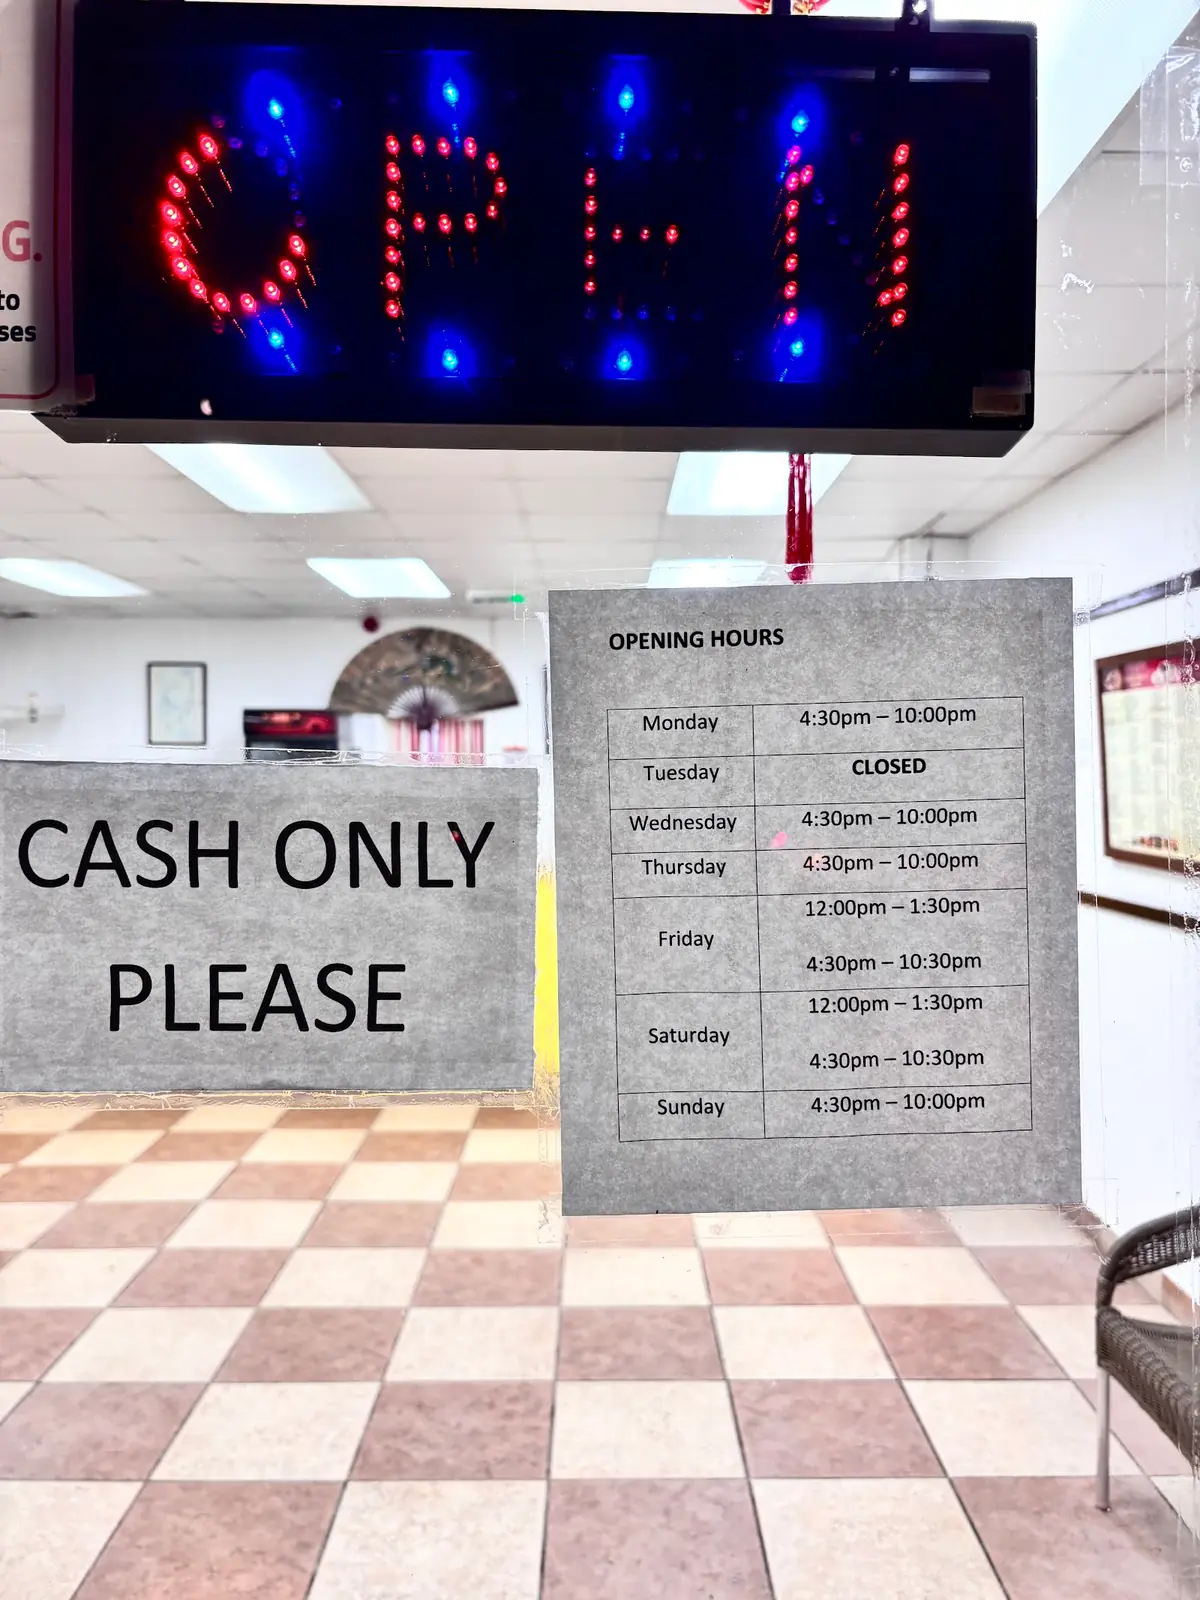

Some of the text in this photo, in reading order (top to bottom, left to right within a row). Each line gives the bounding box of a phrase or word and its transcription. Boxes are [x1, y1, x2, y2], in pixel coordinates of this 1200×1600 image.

[159, 130, 912, 330] OPEN
[608, 627, 785, 651] OPENING HOURS
[642, 712, 719, 733] Monday
[798, 707, 872, 729] 4:30pm
[894, 706, 977, 726] 10:00pm
[642, 763, 720, 784] Tuesday
[851, 757, 927, 776] CLOSED
[628, 813, 738, 834] Wednesday
[800, 809, 873, 830] 4:30pm
[896, 807, 978, 828] 10:00pm
[18, 818, 496, 890] CASH ONLY
[802, 854, 874, 875] 4:30pm
[897, 852, 979, 872] 10:00pm
[641, 857, 727, 878] Thursday
[805, 899, 887, 920] 12:00pm
[910, 897, 980, 917] 1:30pm
[658, 929, 715, 951] Friday
[806, 955, 876, 975] 4:30pm
[899, 952, 982, 973] 10:30pm
[109, 962, 406, 1033] PLEASE
[808, 996, 889, 1016] 12:00pm
[912, 993, 983, 1014] 1:30pm
[648, 1025, 730, 1047] Saturday
[809, 1052, 879, 1073] 4:30pm
[902, 1049, 985, 1070] 10:30pm
[657, 1097, 725, 1119] Sunday
[810, 1095, 881, 1116] 4:30pm
[903, 1092, 985, 1113] 10:00pm
